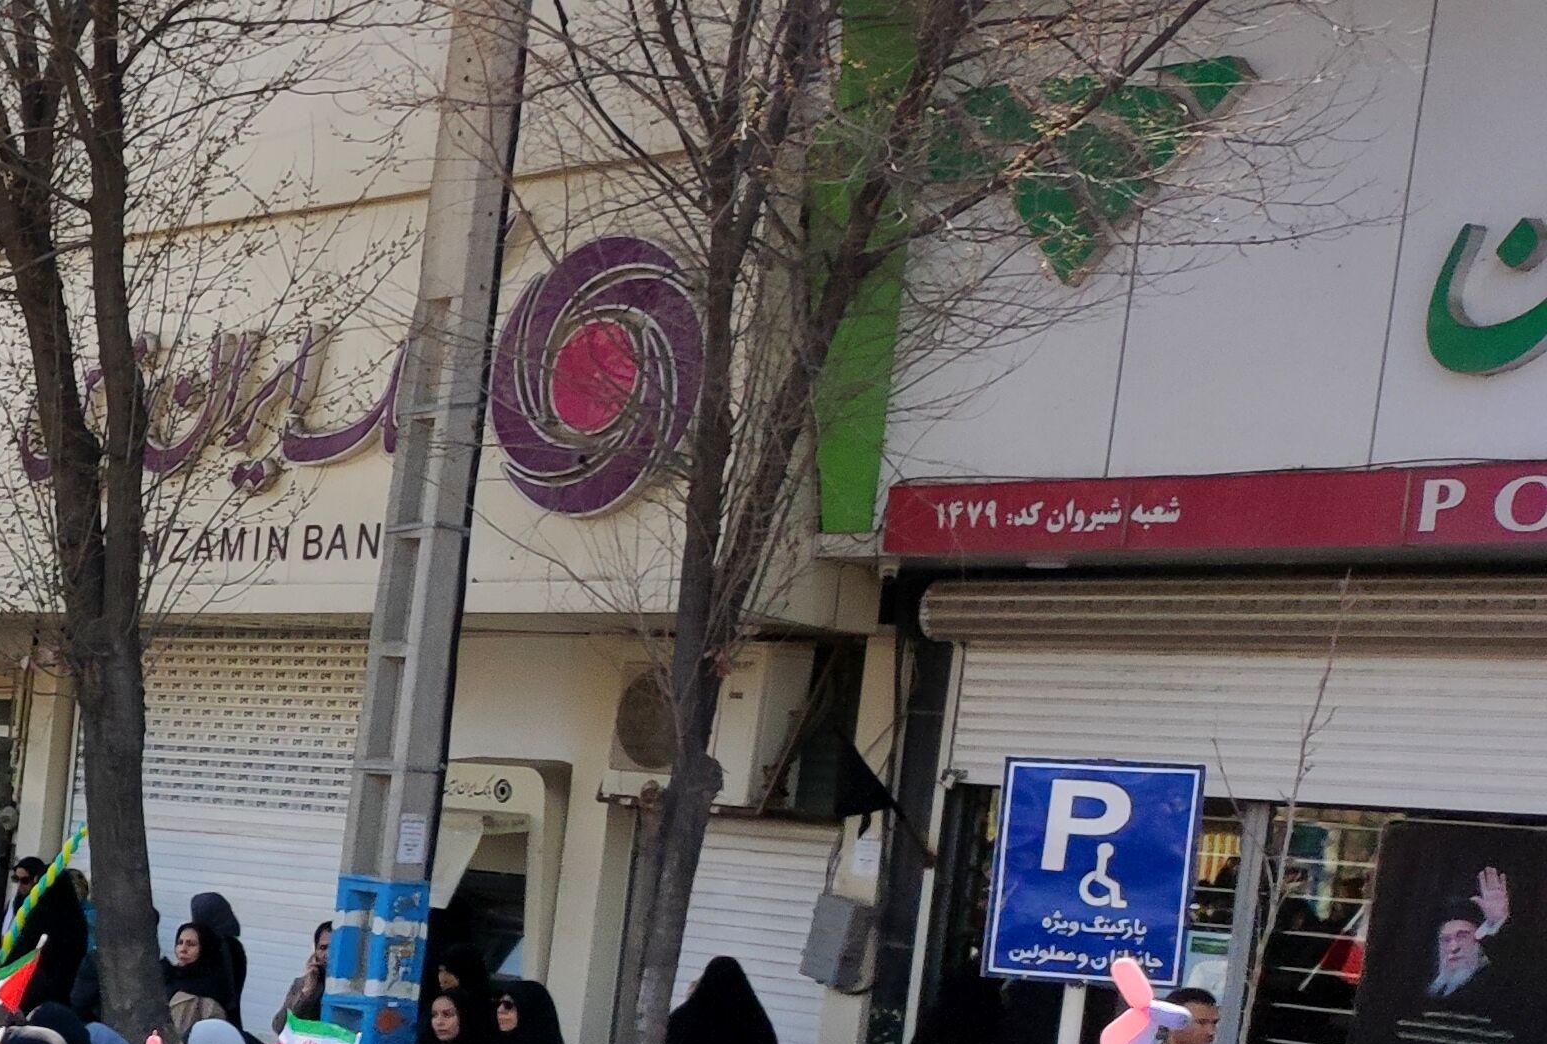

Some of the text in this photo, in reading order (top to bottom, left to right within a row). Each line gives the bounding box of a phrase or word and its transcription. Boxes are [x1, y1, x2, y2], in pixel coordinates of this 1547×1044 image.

[936, 498, 999, 530] ۱۴۷۹
[1045, 496, 1123, 534] شیروان
[1128, 494, 1182, 525] شعبه
[140, 522, 383, 563] NZAMIN BAN
[1040, 778, 1133, 873] P
[1041, 910, 1148, 945] پارکینگ ویژه
[1007, 944, 1077, 966] معلولین
[1076, 952, 1089, 970] و
